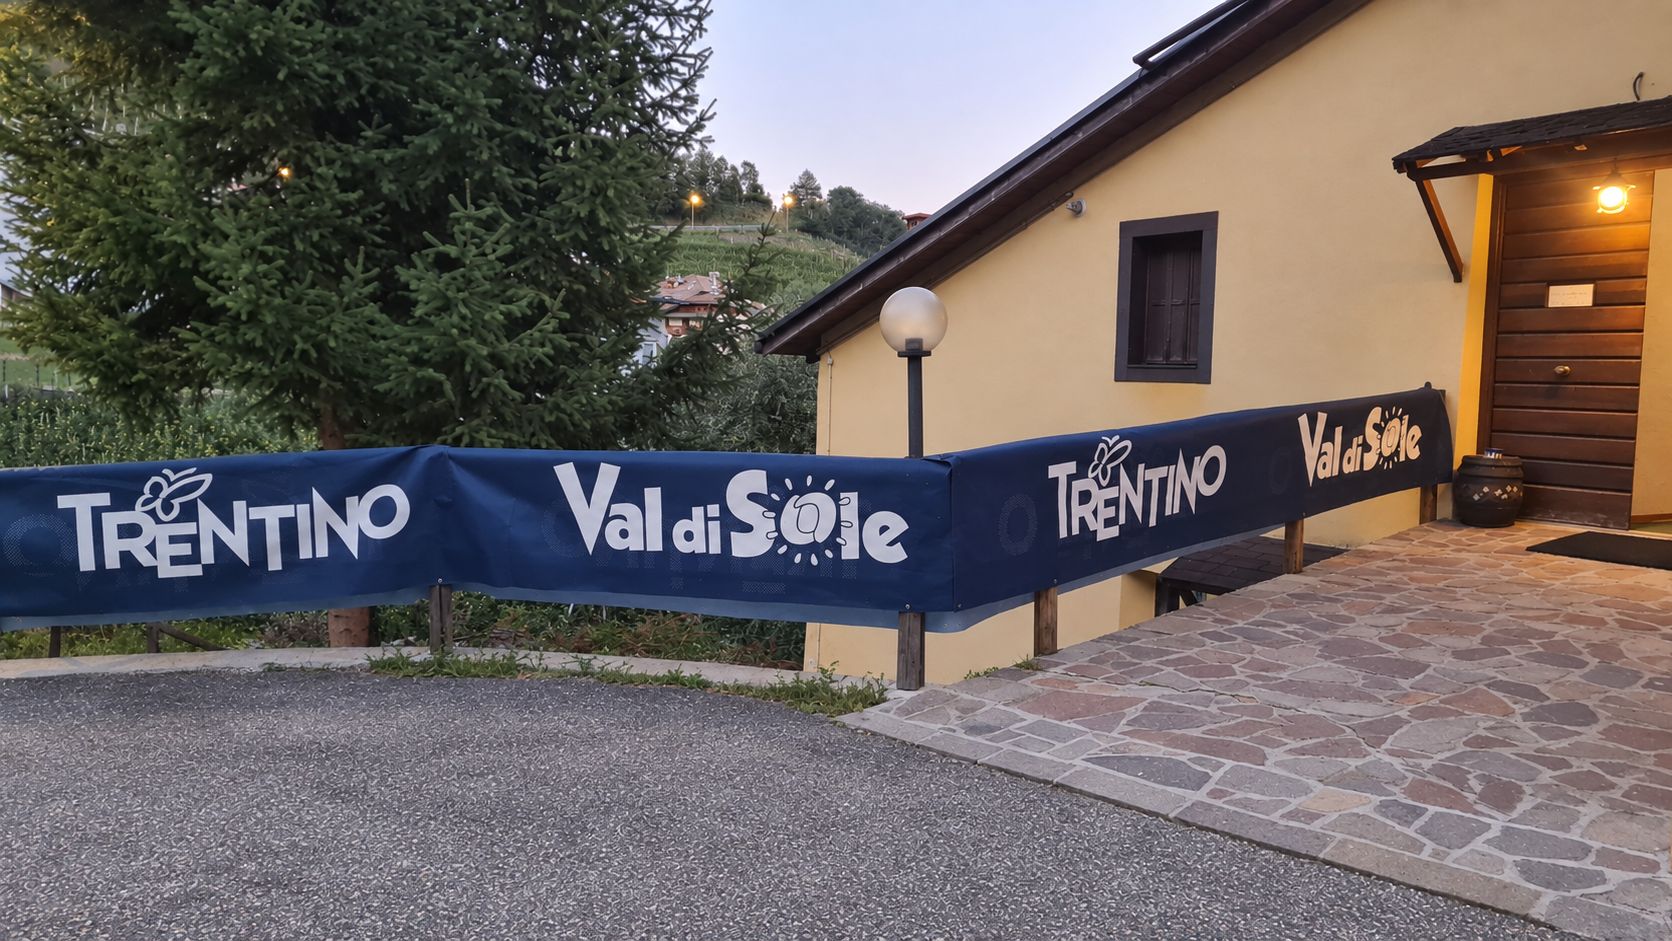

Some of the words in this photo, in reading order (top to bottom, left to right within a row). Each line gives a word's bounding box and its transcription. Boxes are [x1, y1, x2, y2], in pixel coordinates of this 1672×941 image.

[1048, 445, 1227, 541] TRENTINO
[1298, 411, 1343, 487] Val
[1342, 435, 1364, 474] di
[1363, 406, 1422, 471] Sole
[57, 484, 411, 578] TRENTINO
[553, 462, 663, 556] Val
[672, 503, 722, 555] di
[726, 469, 909, 565] Sole
